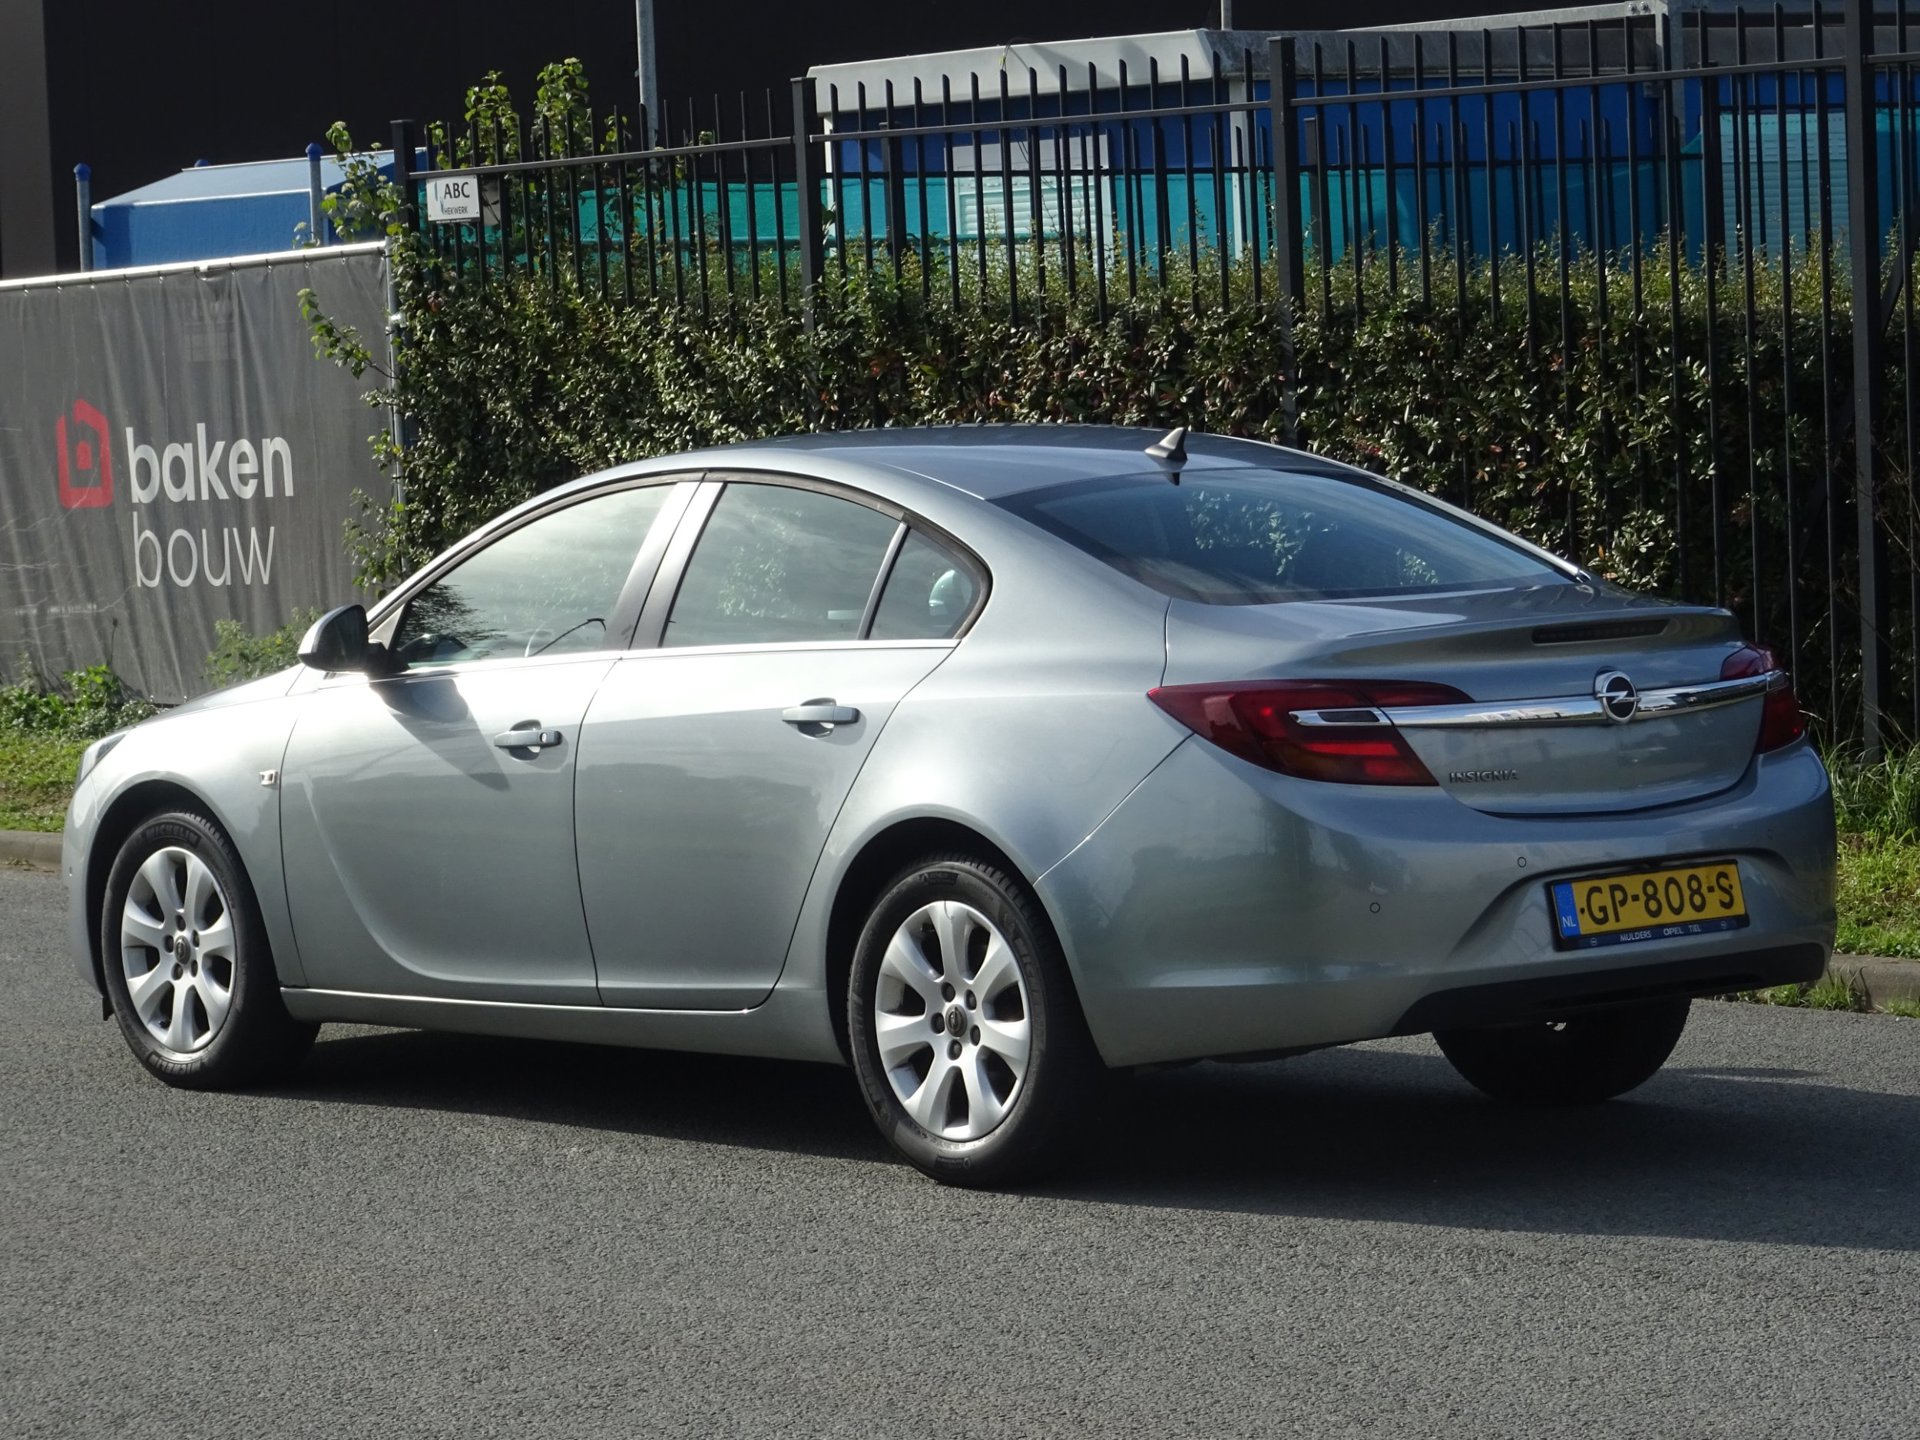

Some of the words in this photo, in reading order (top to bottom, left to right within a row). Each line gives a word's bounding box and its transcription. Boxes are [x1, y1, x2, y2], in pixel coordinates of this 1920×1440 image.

[444, 181, 470, 199] ABC
[126, 423, 294, 503] baken
[133, 511, 275, 587] bouw
[1449, 769, 1520, 783] INSIGNIA
[1586, 871, 1735, 925] GP-808-S
[1562, 916, 1577, 928] NL
[1620, 930, 1652, 941] MULDERS
[1663, 926, 1684, 936] OPEL
[1688, 924, 1701, 932] TIEL
